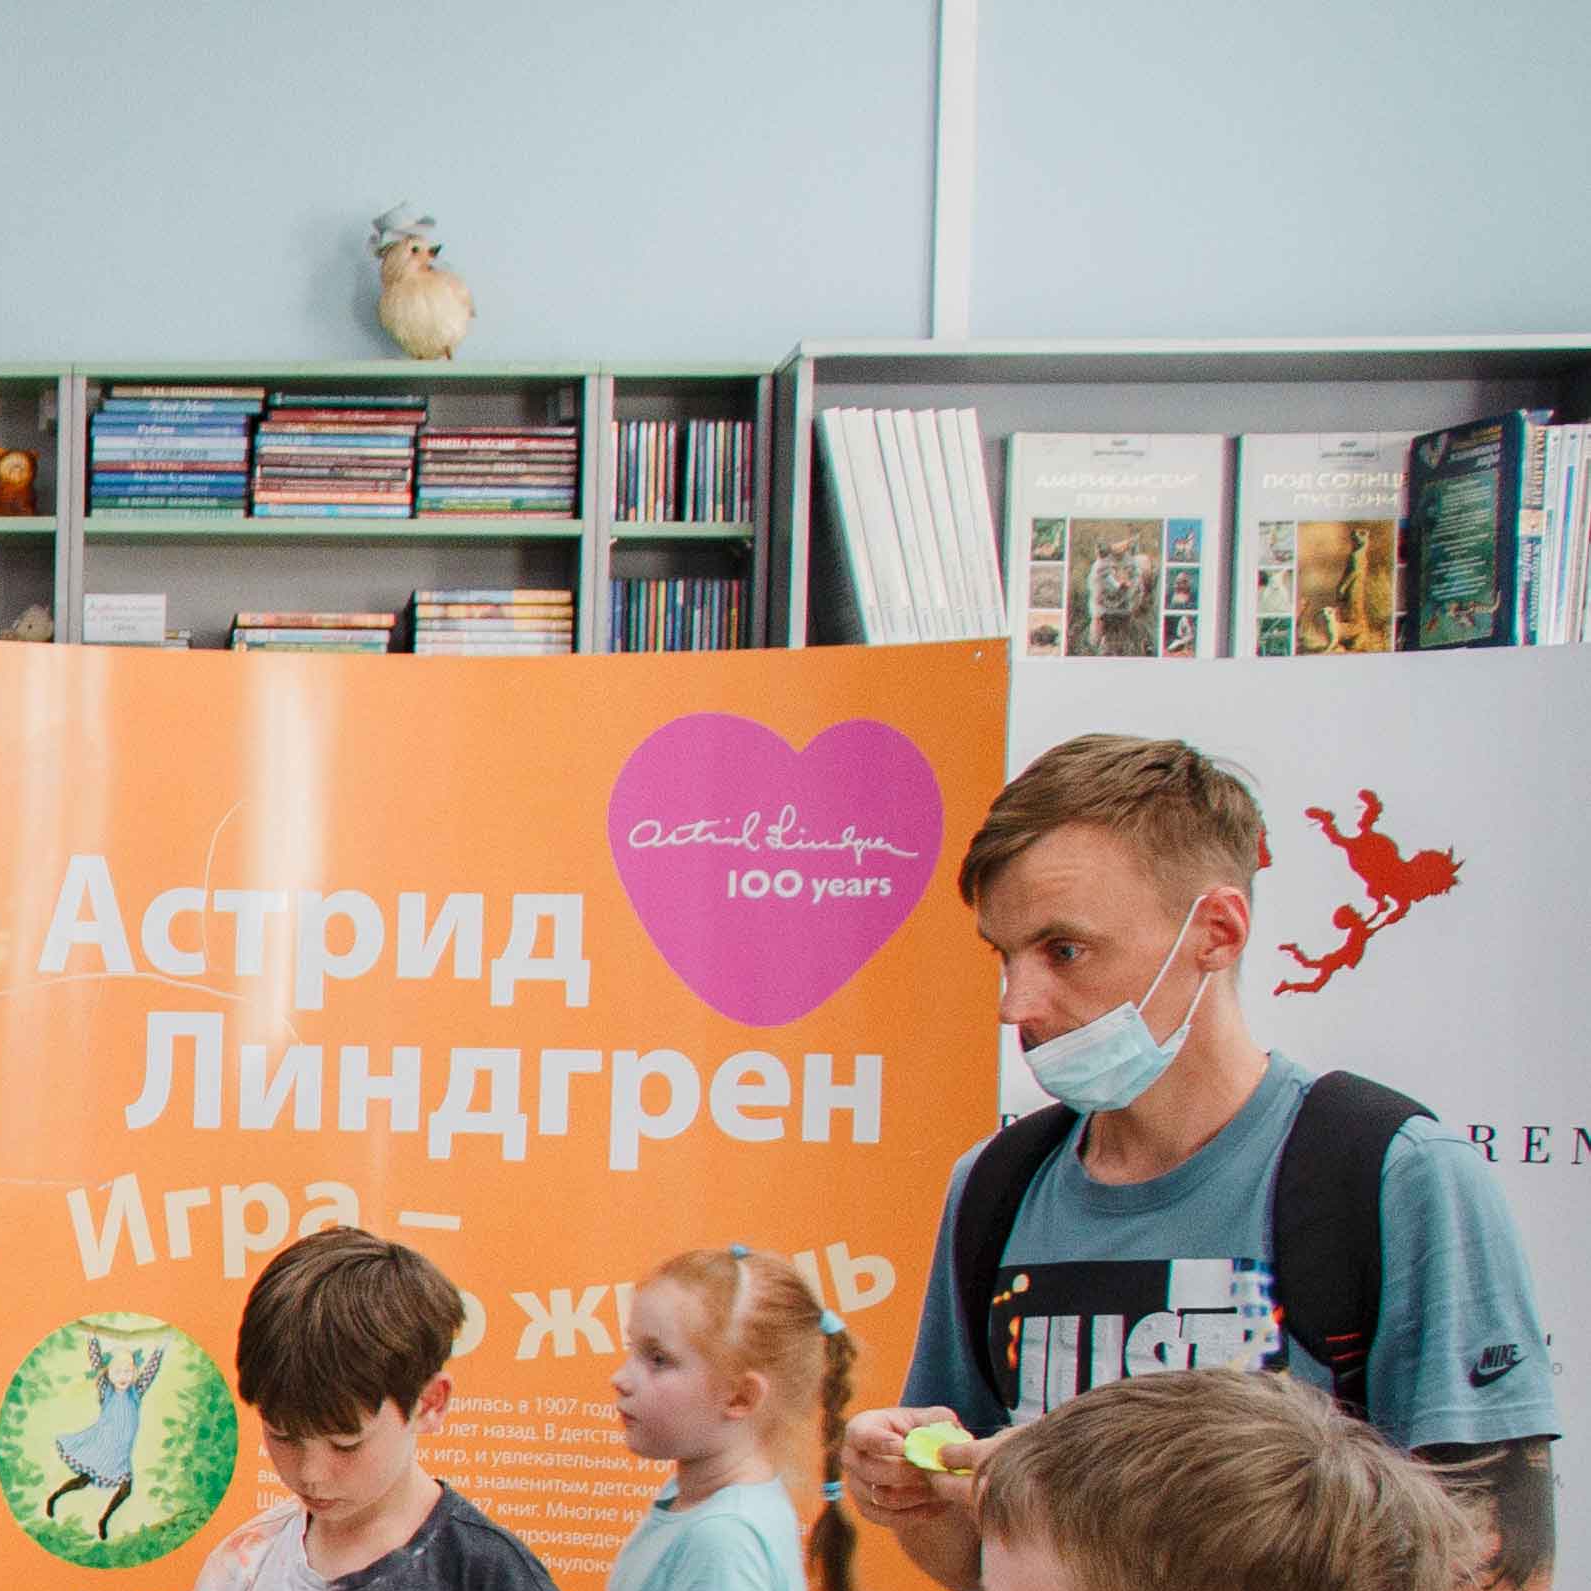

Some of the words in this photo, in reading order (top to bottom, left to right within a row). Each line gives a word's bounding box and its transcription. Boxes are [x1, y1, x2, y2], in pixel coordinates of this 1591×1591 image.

[725, 869, 805, 899] 100
[811, 876, 893, 905] years
[36, 853, 593, 1008] Астрид
[123, 1008, 885, 1172] Линдгрен
[65, 1174, 365, 1282] Игра
[1478, 1343, 1520, 1371] NIKE
[446, 1396, 513, 1414] дилась
[536, 1397, 578, 1415] 1907
[448, 1423, 479, 1438] лет
[483, 1424, 540, 1442] назад.
[544, 1423, 556, 1441] В
[474, 1475, 589, 1496] знаменитым
[497, 1501, 540, 1518] книг.
[545, 1501, 619, 1522] Многие
